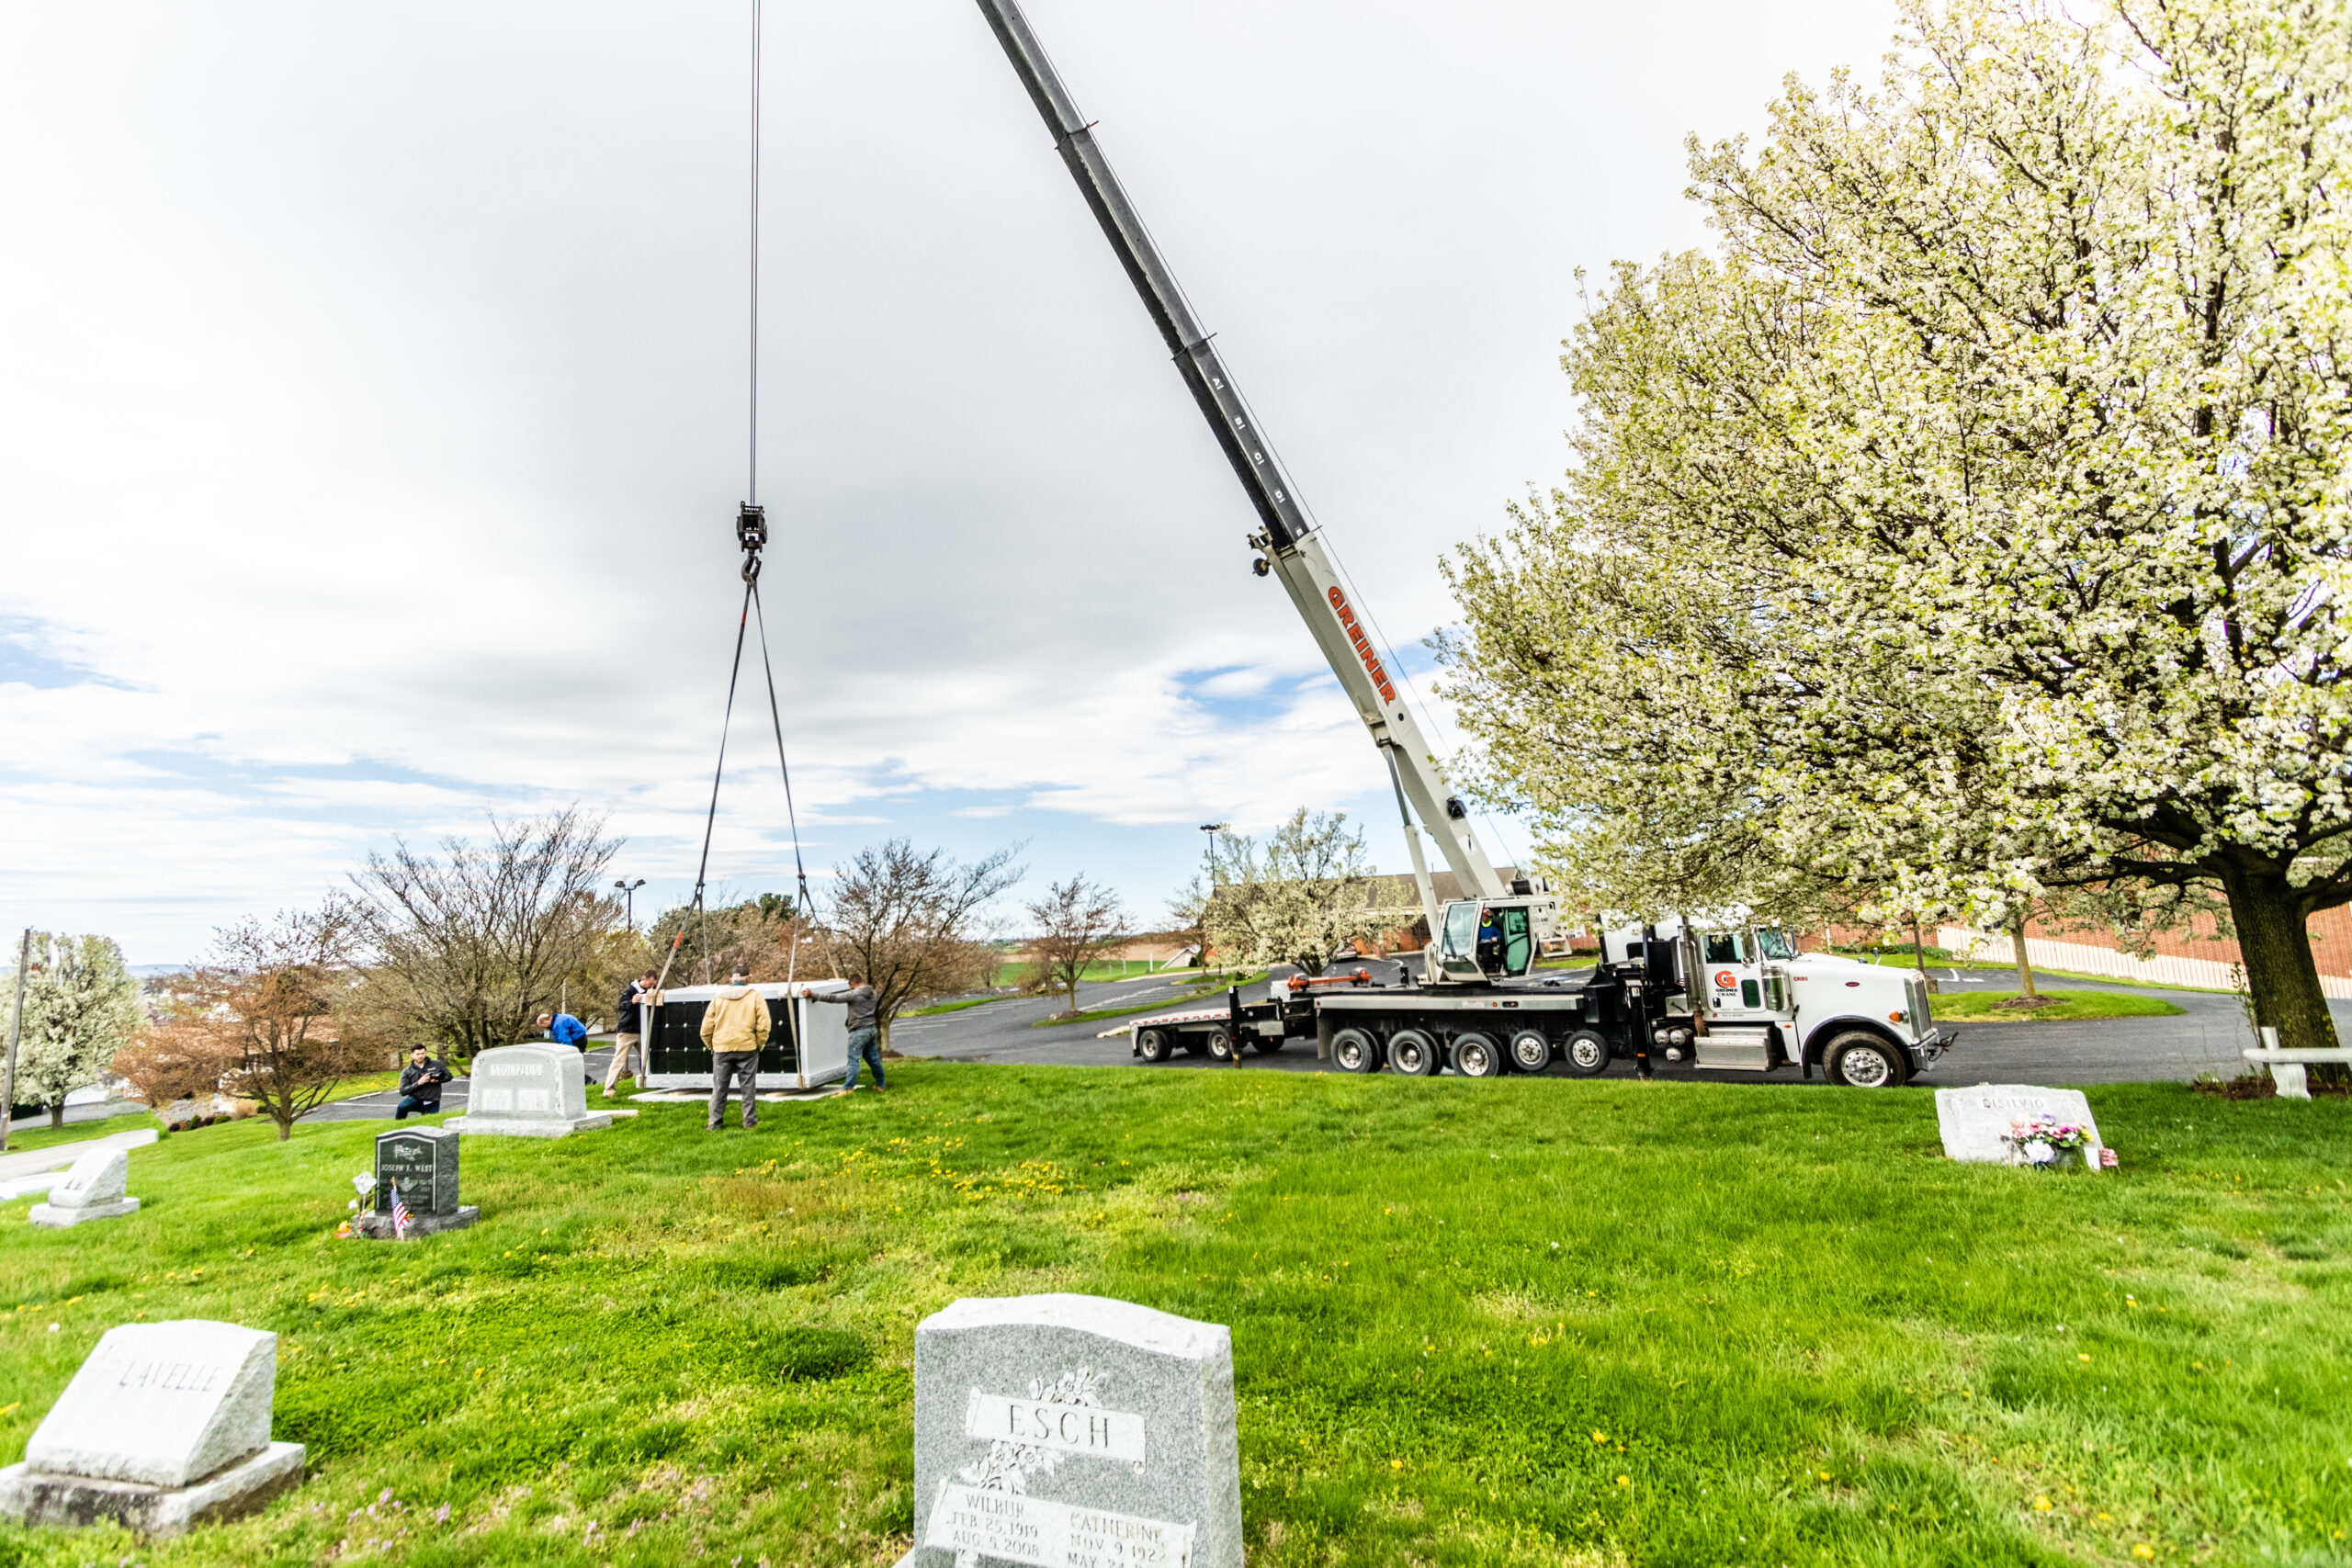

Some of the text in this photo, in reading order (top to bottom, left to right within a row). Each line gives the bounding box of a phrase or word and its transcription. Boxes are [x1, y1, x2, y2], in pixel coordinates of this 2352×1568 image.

[1328, 585, 1396, 706] GREINER
[1714, 970, 1736, 988] G
[380, 1164, 404, 1172] JOSEPH
[414, 1164, 433, 1173] WEST
[119, 1359, 225, 1392] LAVELLE
[1009, 1404, 1110, 1449] ESCH
[966, 1494, 1024, 1518] WILBUR
[1010, 1521, 1039, 1538] 1919
[1069, 1511, 1163, 1543] CATHERINE
[1004, 1539, 1039, 1558] 2008
[1068, 1551, 1097, 1568] MAY
